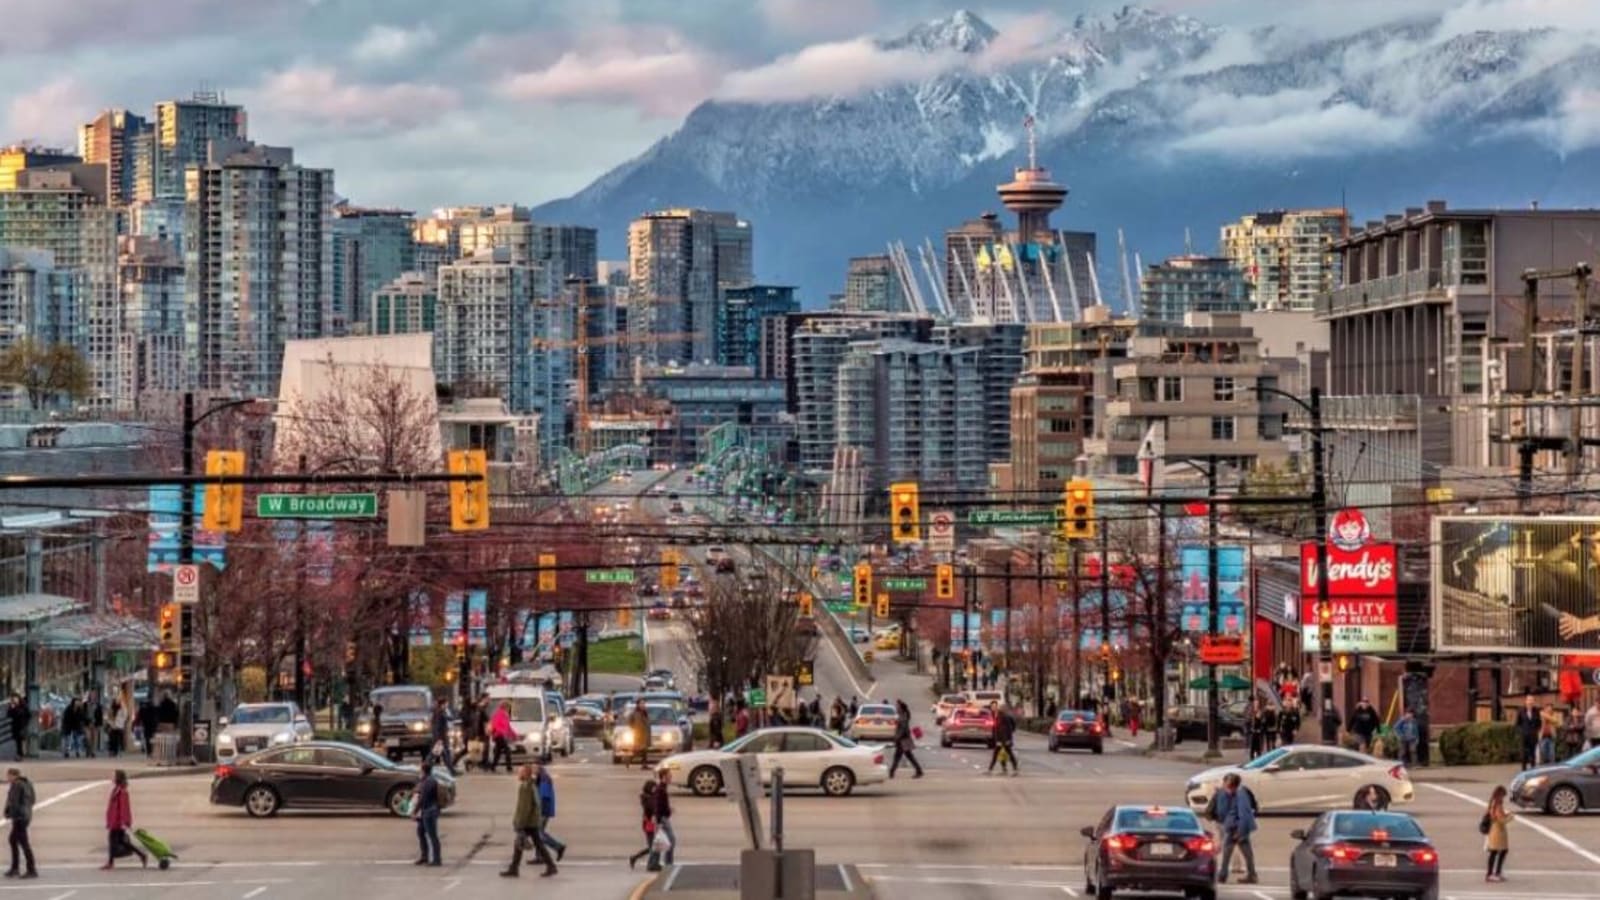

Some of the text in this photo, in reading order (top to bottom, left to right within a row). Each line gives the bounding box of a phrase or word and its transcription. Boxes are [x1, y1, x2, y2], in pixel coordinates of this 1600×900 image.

[268, 495, 367, 514] W Broadway
[1307, 551, 1392, 587] Wendy's
[1312, 602, 1386, 615] QUALITY
